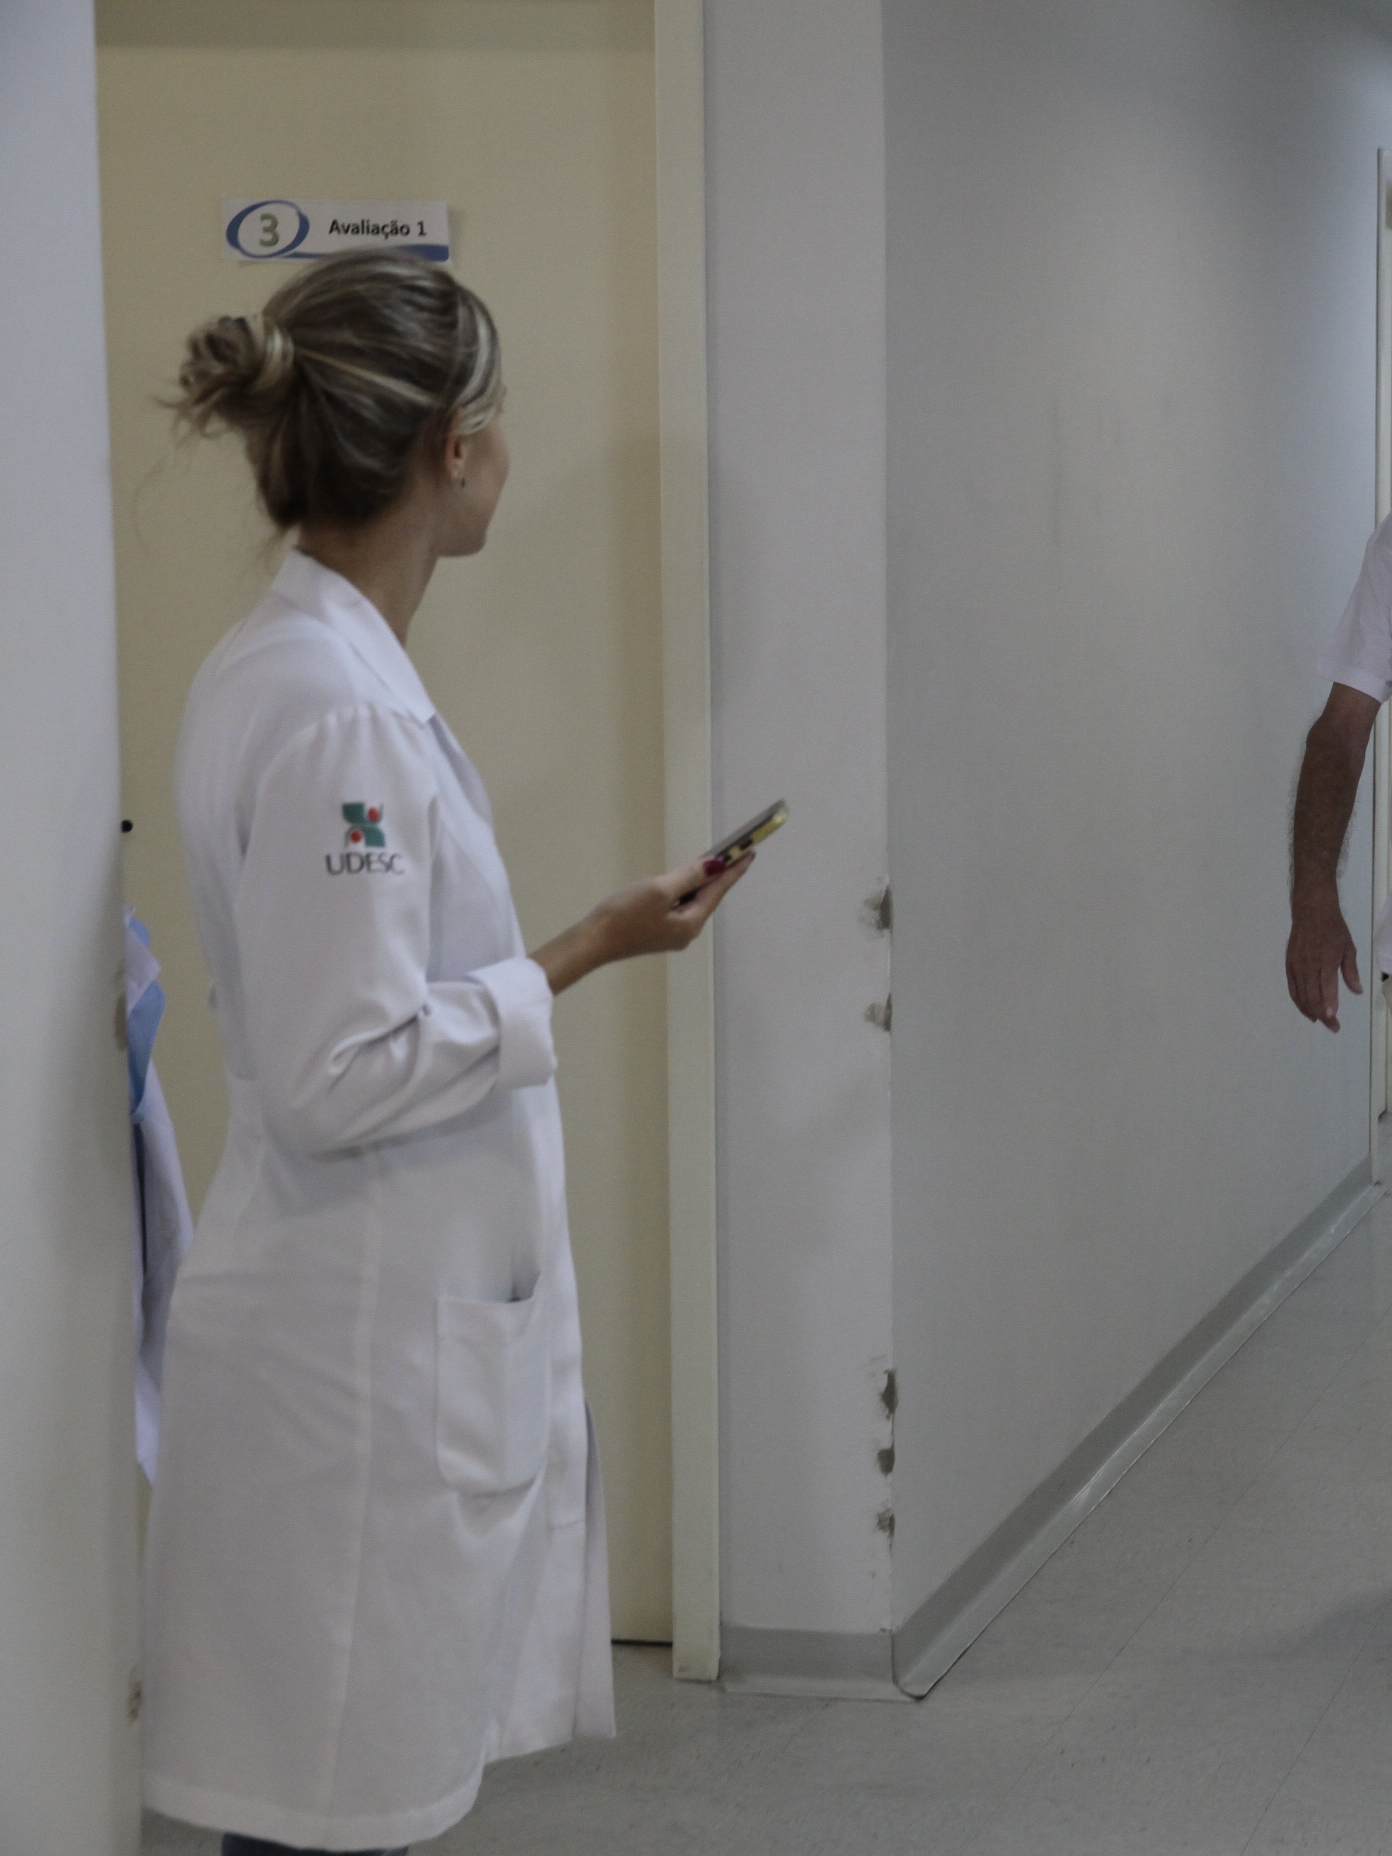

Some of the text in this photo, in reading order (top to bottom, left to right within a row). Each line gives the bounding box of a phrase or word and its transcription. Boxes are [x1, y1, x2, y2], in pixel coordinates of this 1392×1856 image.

[259, 213, 280, 247] 3
[328, 218, 427, 240] Avaliação 1
[325, 851, 405, 876] UDESC
